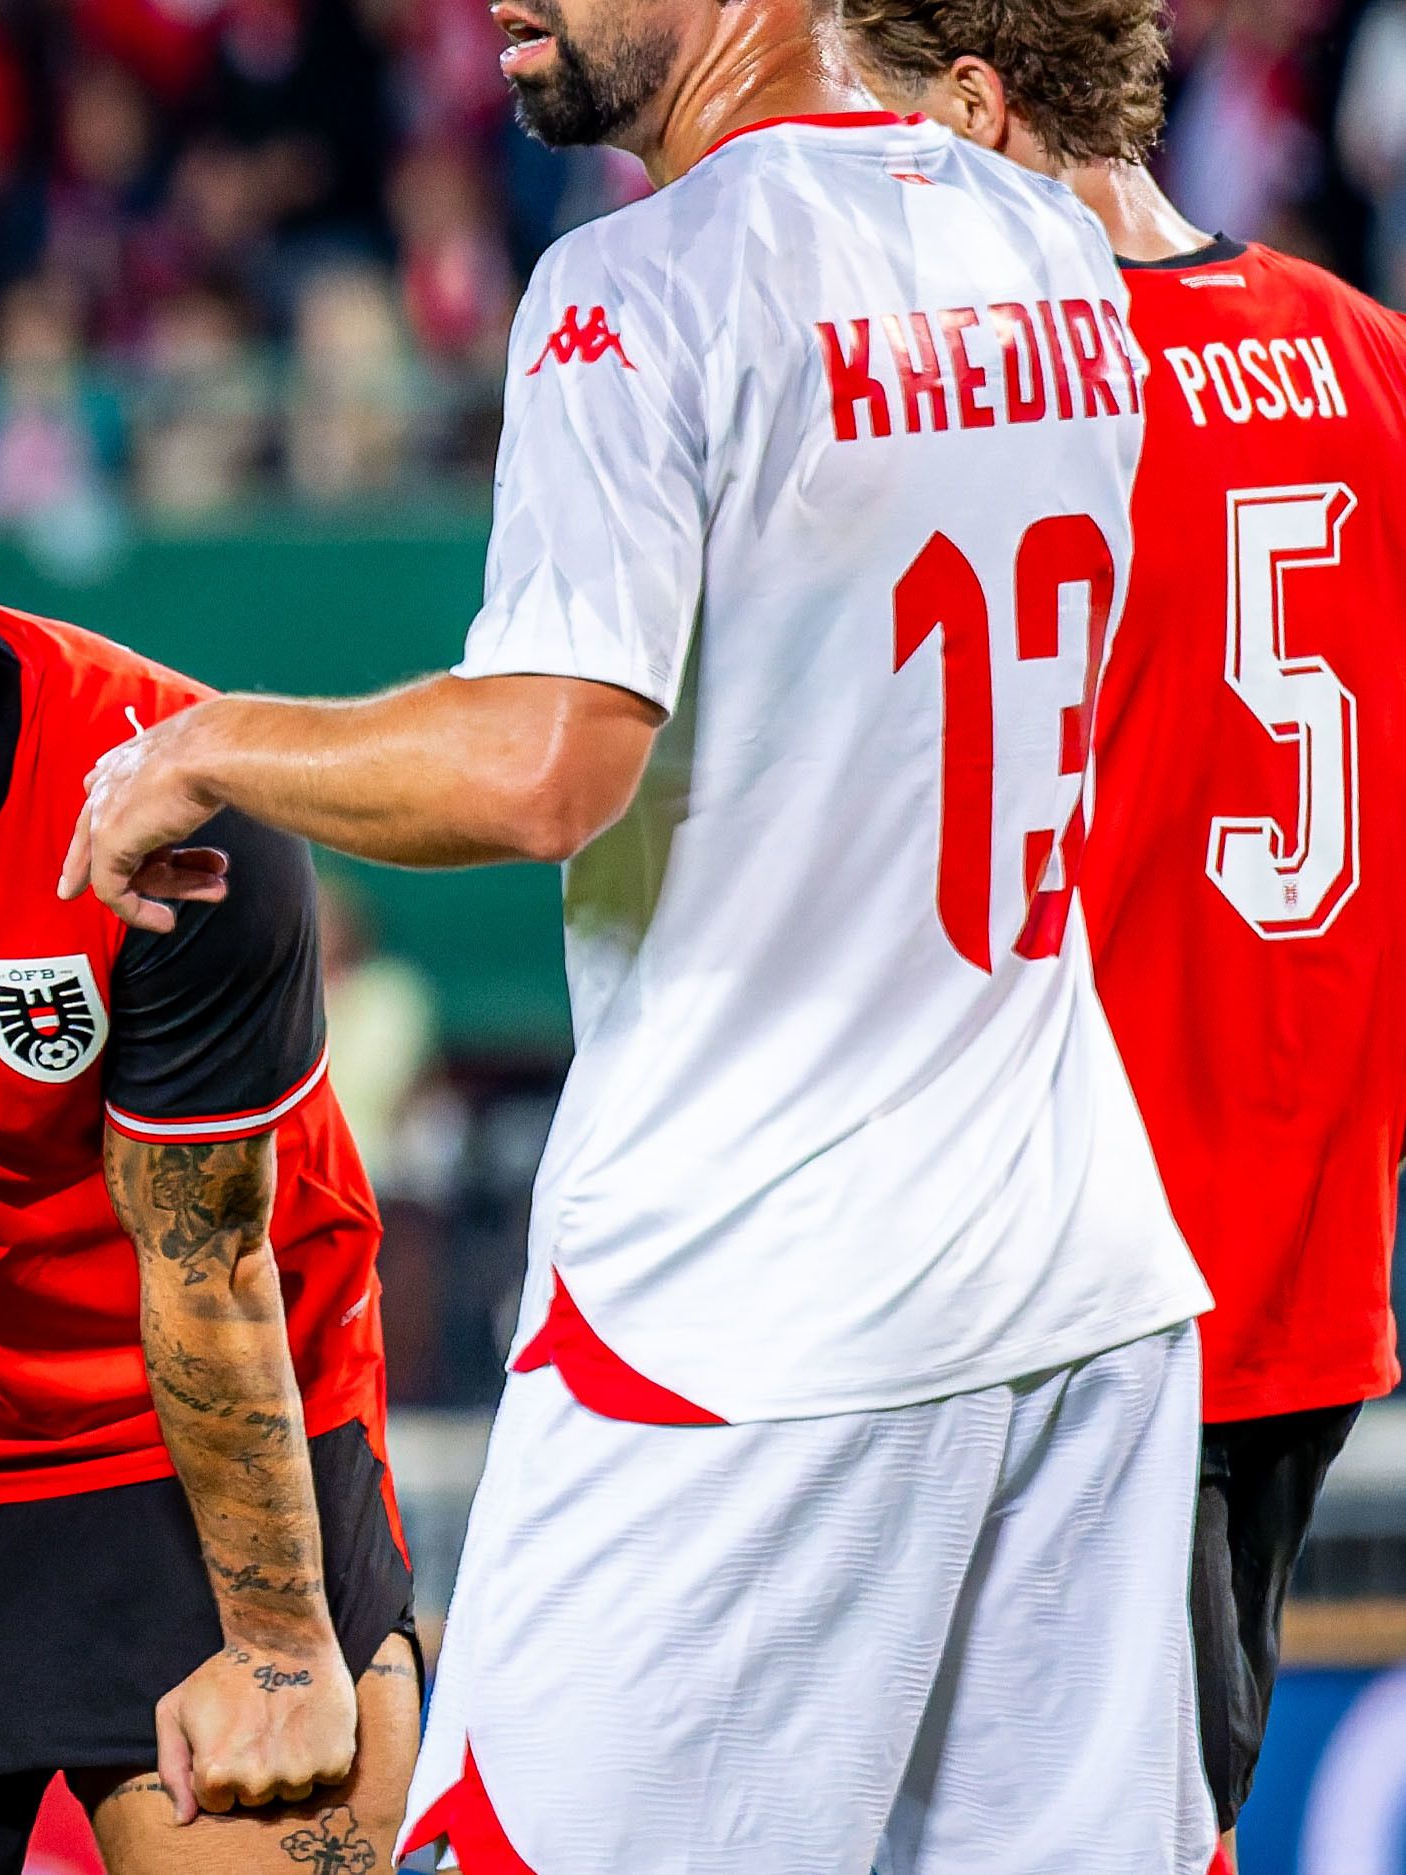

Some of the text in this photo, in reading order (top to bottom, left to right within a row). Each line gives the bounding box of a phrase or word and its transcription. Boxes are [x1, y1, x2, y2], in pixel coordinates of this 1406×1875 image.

[1162, 336, 1348, 427] POSCH
[1205, 481, 1361, 941] 5
[8, 968, 55, 982] ÖFB
